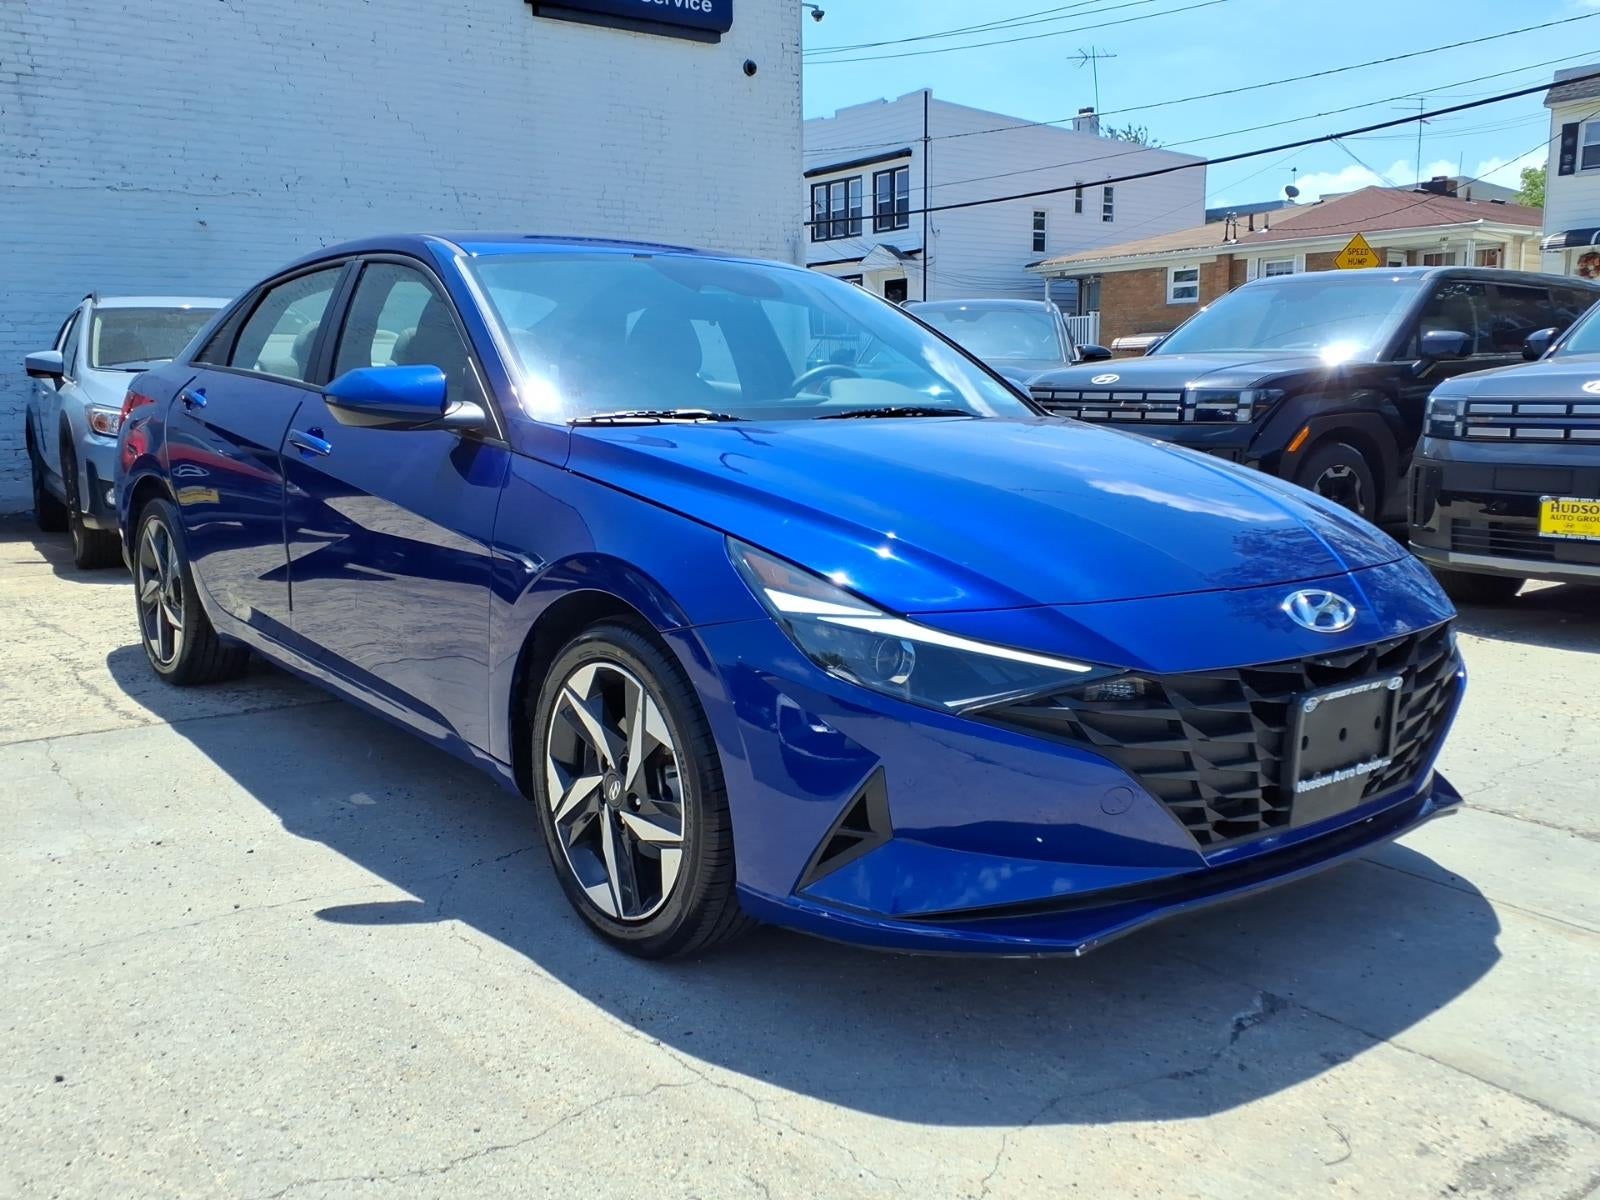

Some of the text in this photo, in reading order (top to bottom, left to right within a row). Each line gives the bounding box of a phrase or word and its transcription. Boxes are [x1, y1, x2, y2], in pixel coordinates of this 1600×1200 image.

[641, 0, 713, 13] vice
[1347, 248, 1369, 256] SPEED
[1347, 257, 1368, 266] HUMP
